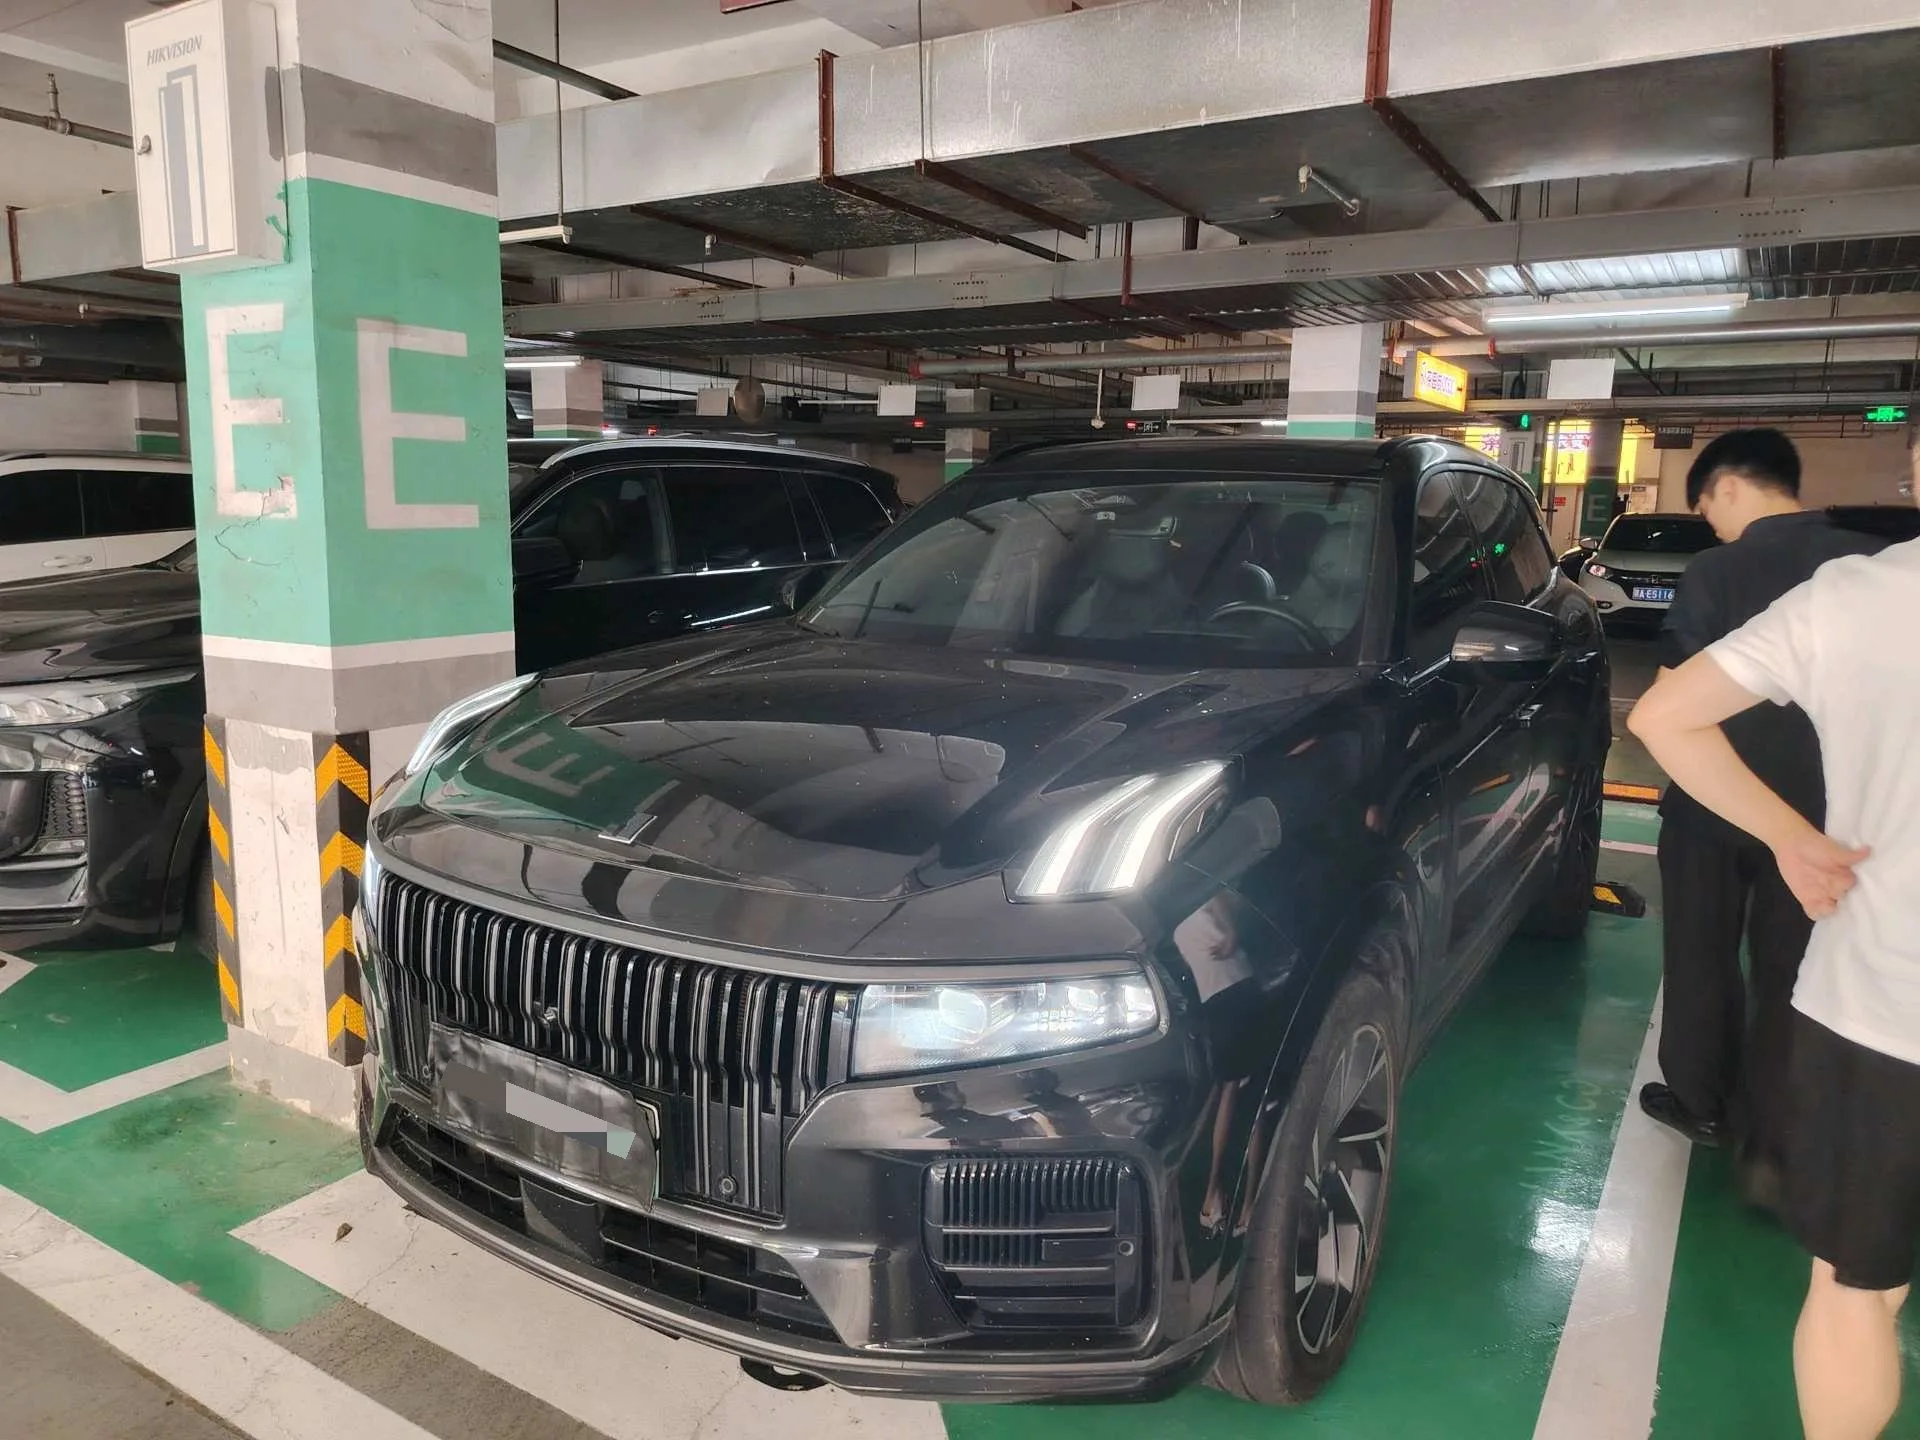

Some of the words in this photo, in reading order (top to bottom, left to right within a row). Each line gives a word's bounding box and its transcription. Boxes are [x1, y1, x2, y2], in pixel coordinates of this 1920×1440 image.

[147, 34, 203, 67] HIKVISION
[206, 303, 297, 519] E
[356, 318, 480, 530] E
[1587, 494, 1608, 522] E
